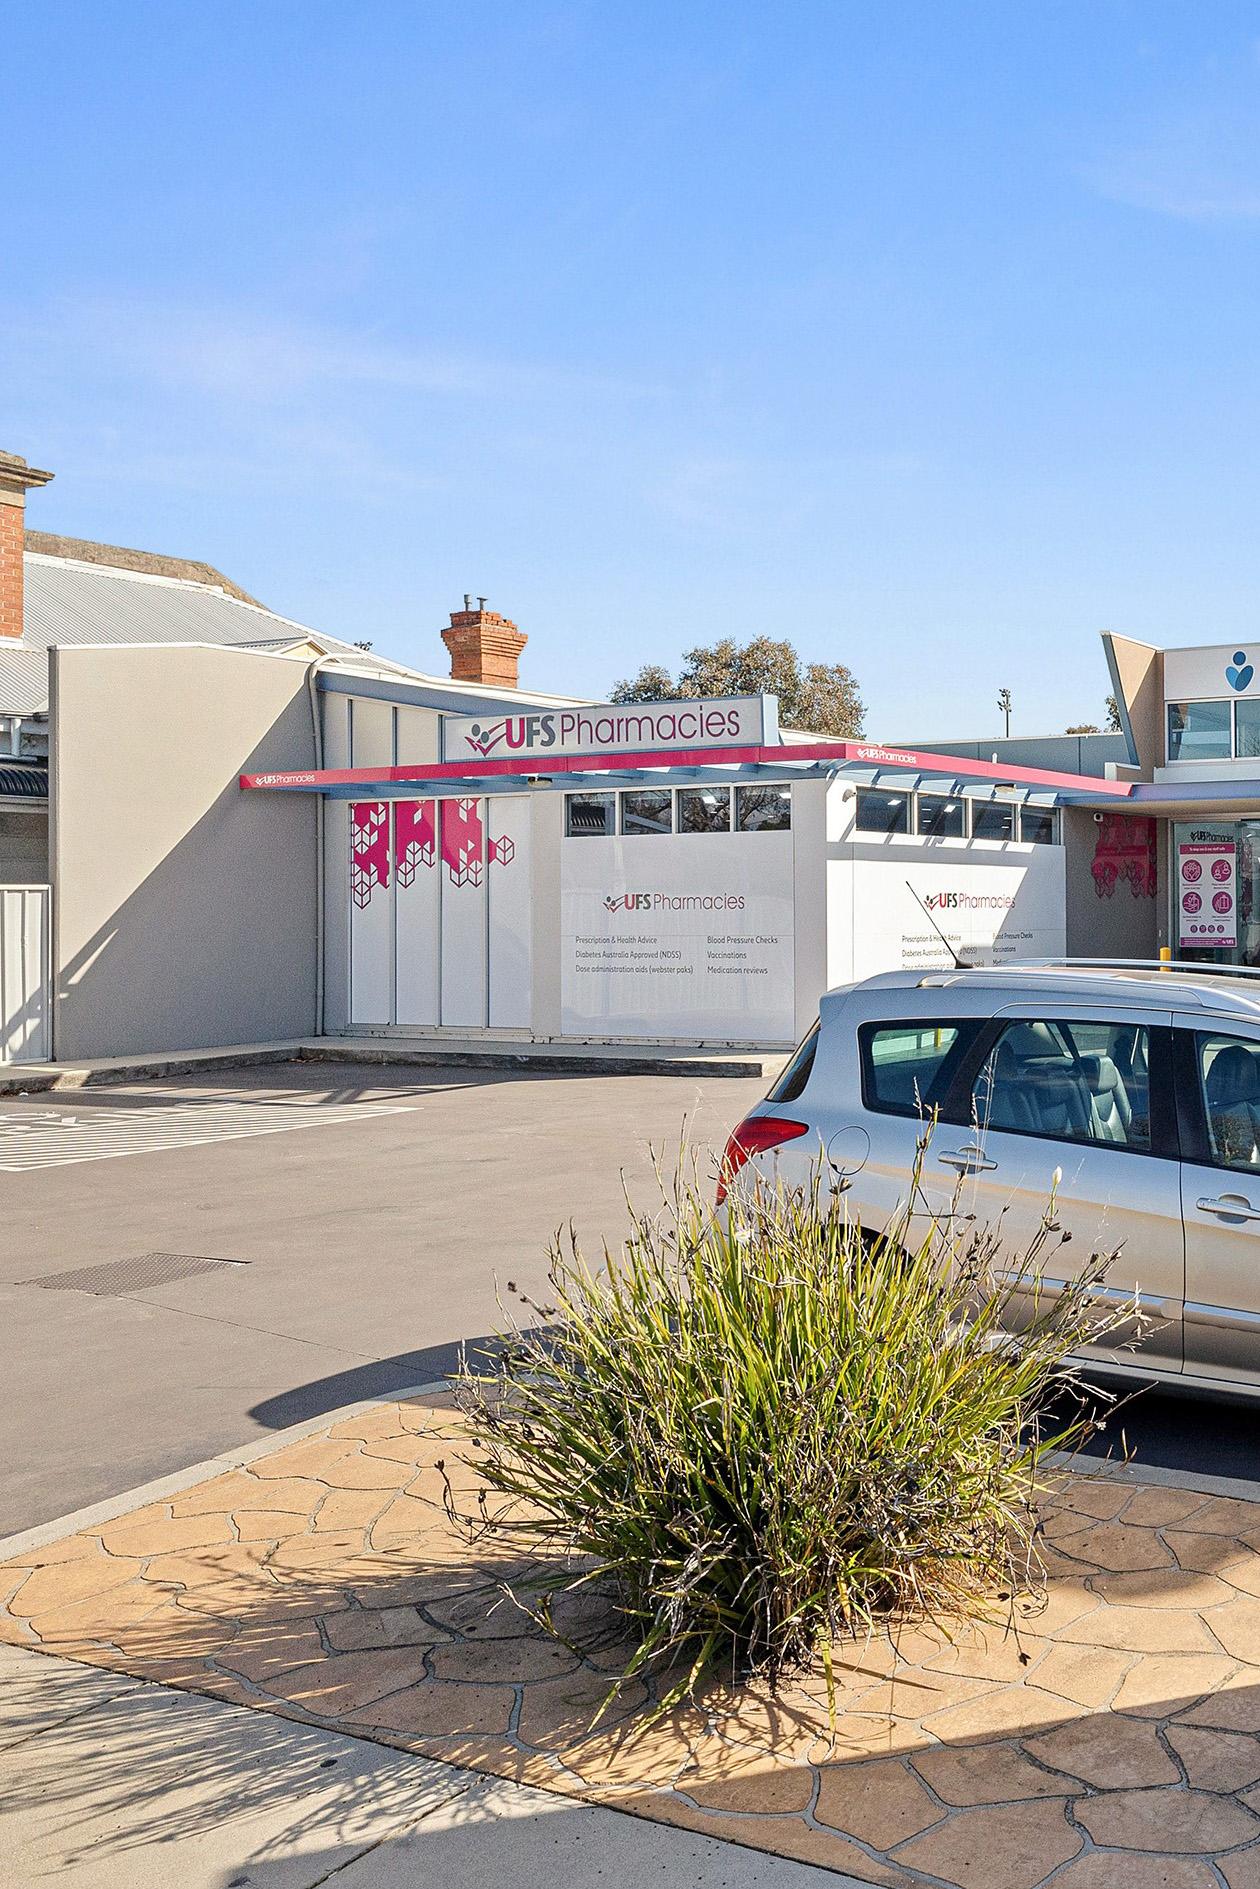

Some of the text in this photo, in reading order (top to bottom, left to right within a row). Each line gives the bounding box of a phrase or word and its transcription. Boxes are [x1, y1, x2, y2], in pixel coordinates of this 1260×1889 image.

[505, 705, 741, 748] UFS Pharmacies
[880, 749, 917, 764] Pharmacies
[276, 774, 315, 783] Pharmacies
[624, 893, 745, 910] UFS Pharmacies
[939, 893, 1016, 909] UFS Pharmacies
[575, 936, 658, 945] Prescription & Health Advice
[707, 935, 778, 944] Blood Pressure Checks
[575, 950, 682, 960] Diabetes Australia Approved (NDSS)
[706, 951, 747, 959] Vaccinations
[575, 965, 693, 975] Dose administration aids (webster paks)
[707, 966, 768, 974] Medication reviews
